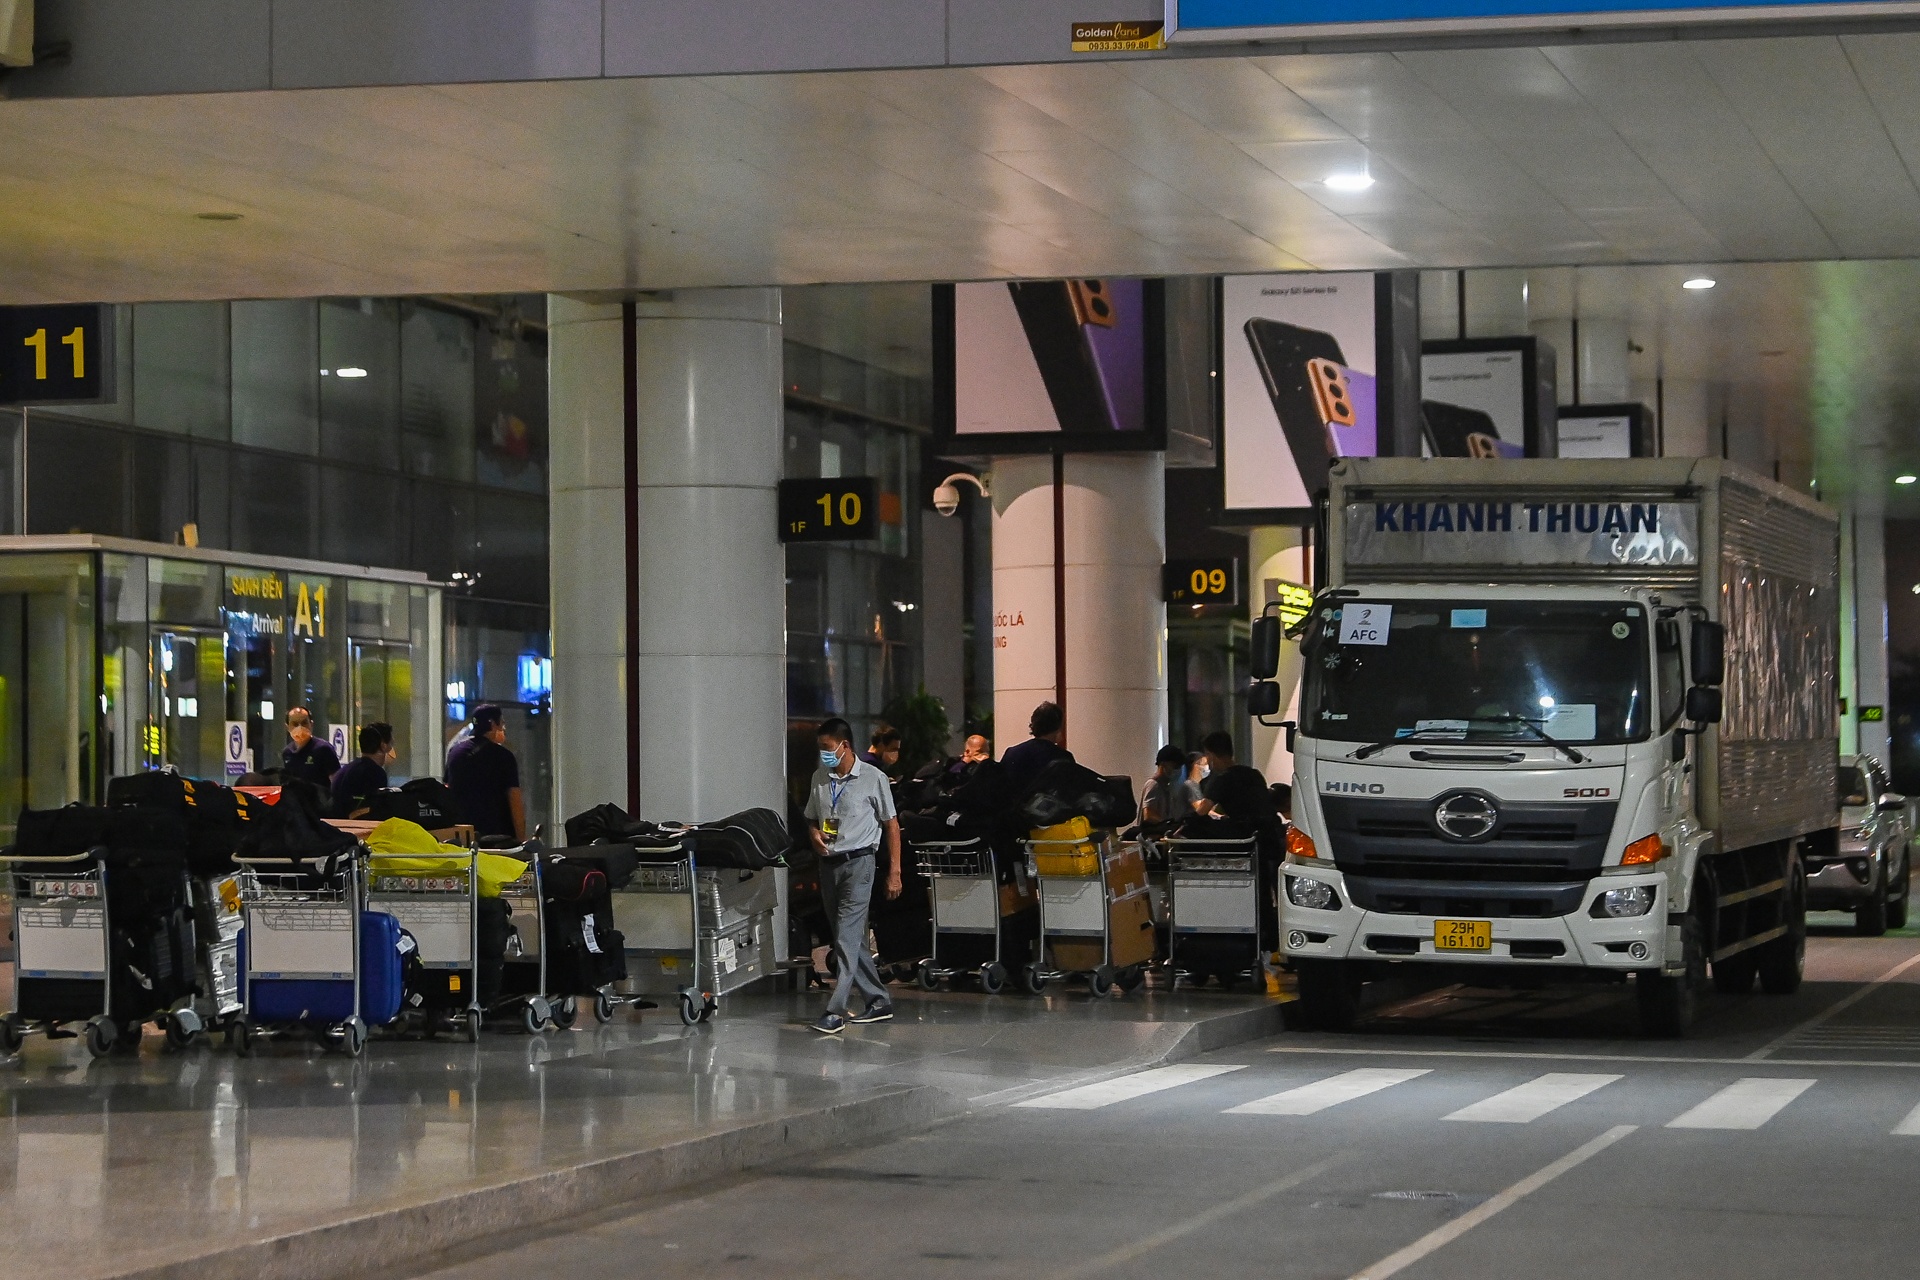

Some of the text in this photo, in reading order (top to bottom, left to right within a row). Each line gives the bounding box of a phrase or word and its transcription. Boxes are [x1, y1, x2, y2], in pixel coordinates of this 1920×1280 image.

[1076, 28, 1113, 38] Golden
[24, 326, 85, 380] 11
[816, 492, 862, 527] 10
[789, 520, 807, 533] 1F
[1191, 568, 1227, 595] 09
[293, 581, 326, 638] A1
[251, 612, 283, 635] Arrival
[1010, 610, 1025, 627] LÁ
[1349, 629, 1378, 641] AFC
[1325, 781, 1385, 795] HINO
[1563, 787, 1610, 798] 500
[1450, 922, 1475, 934] 29H
[1442, 935, 1485, 947] 161.10
